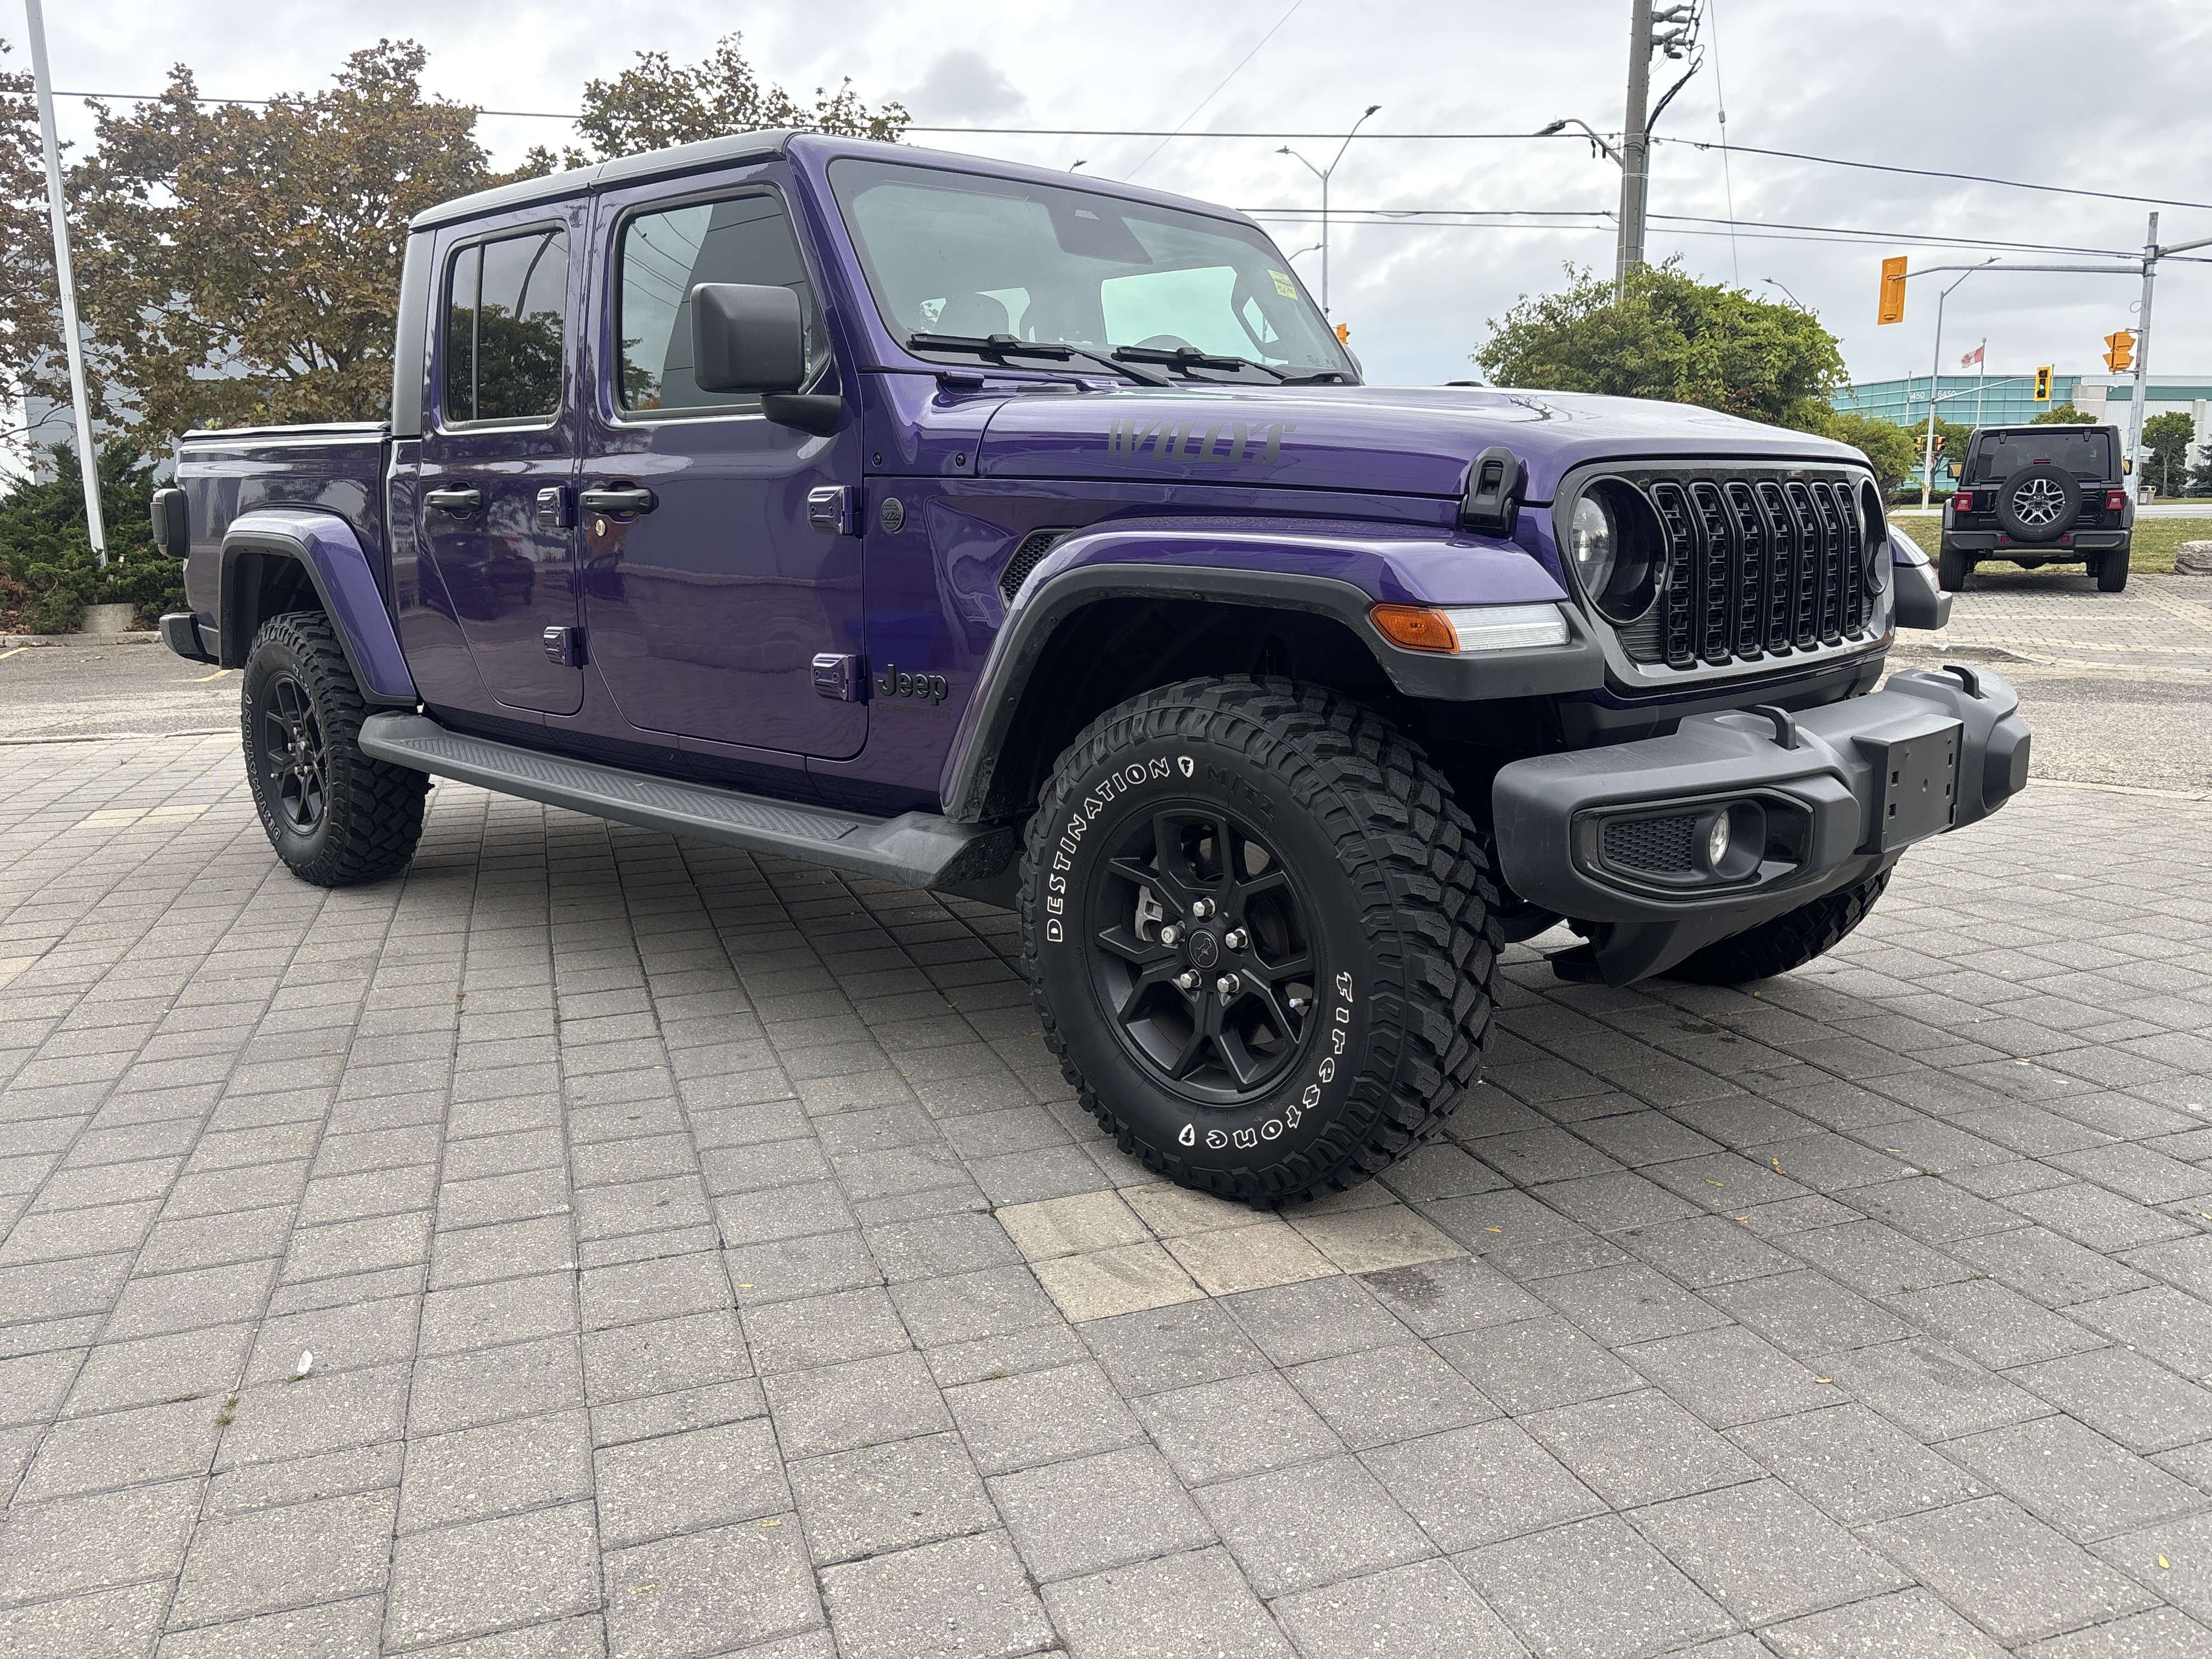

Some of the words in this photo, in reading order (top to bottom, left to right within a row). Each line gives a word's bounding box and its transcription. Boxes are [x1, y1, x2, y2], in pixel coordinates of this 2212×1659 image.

[1108, 419, 1297, 466] WILLYS
[877, 663, 949, 706] Jeep
[245, 708, 281, 841] DESTINATION
[1046, 755, 1170, 942] DESTINATION
[1206, 972, 1353, 1149] Firestone
